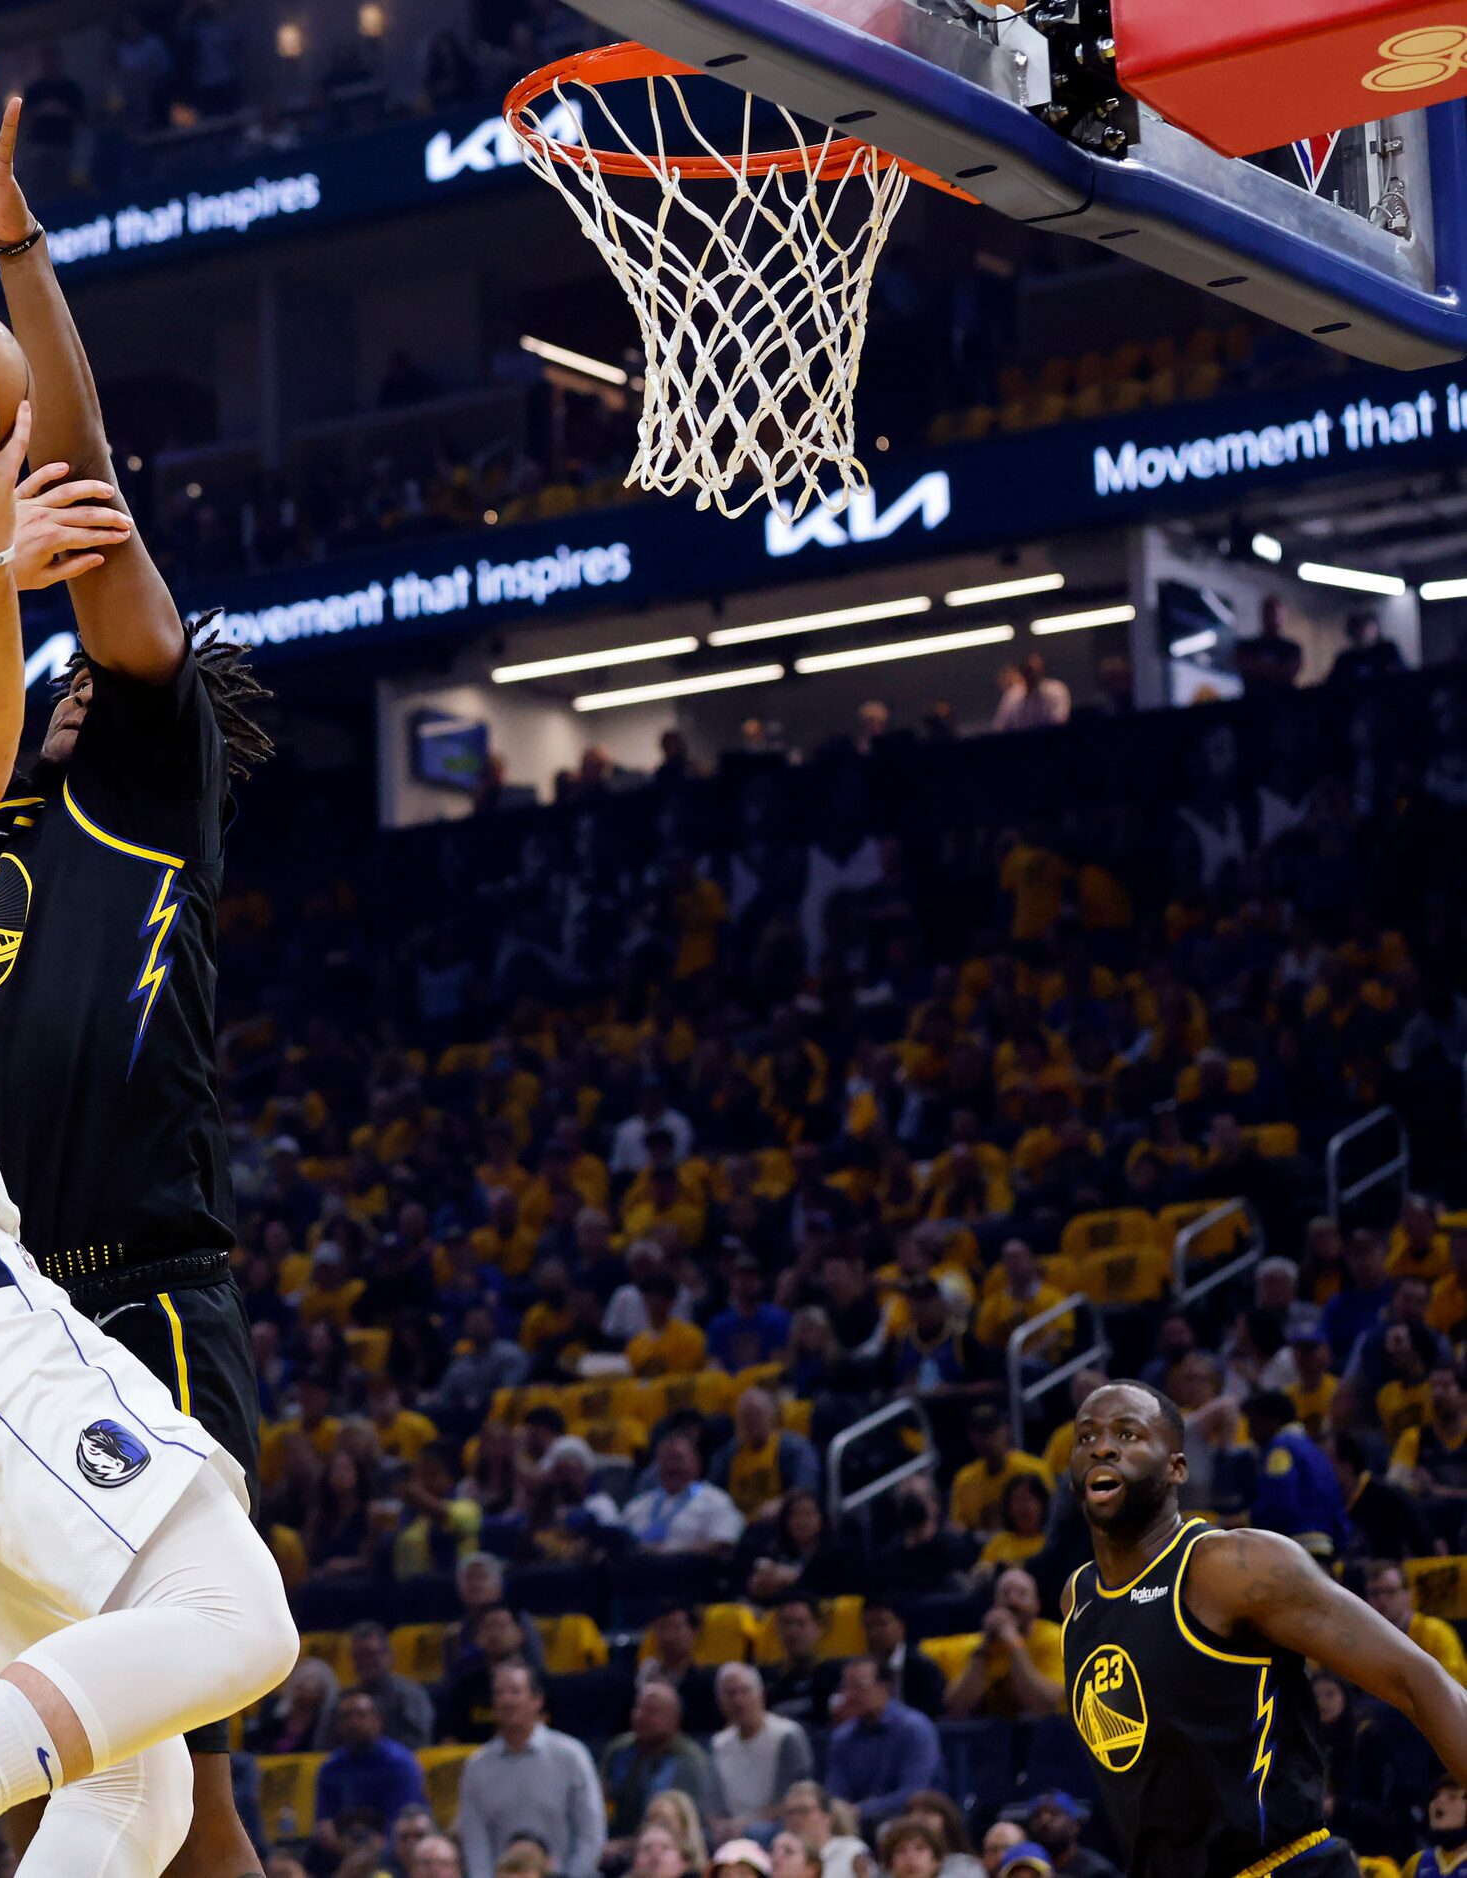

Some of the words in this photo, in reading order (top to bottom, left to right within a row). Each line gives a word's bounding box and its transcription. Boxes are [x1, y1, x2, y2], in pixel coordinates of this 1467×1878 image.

[115, 201, 184, 250] that
[187, 173, 320, 231] inspires
[1093, 409, 1333, 496] Movement
[1340, 390, 1437, 451] that
[391, 565, 472, 620] that
[476, 542, 631, 605] inspires
[1130, 1585, 1169, 1603] Rakuten
[1094, 1653, 1124, 1694] 23
